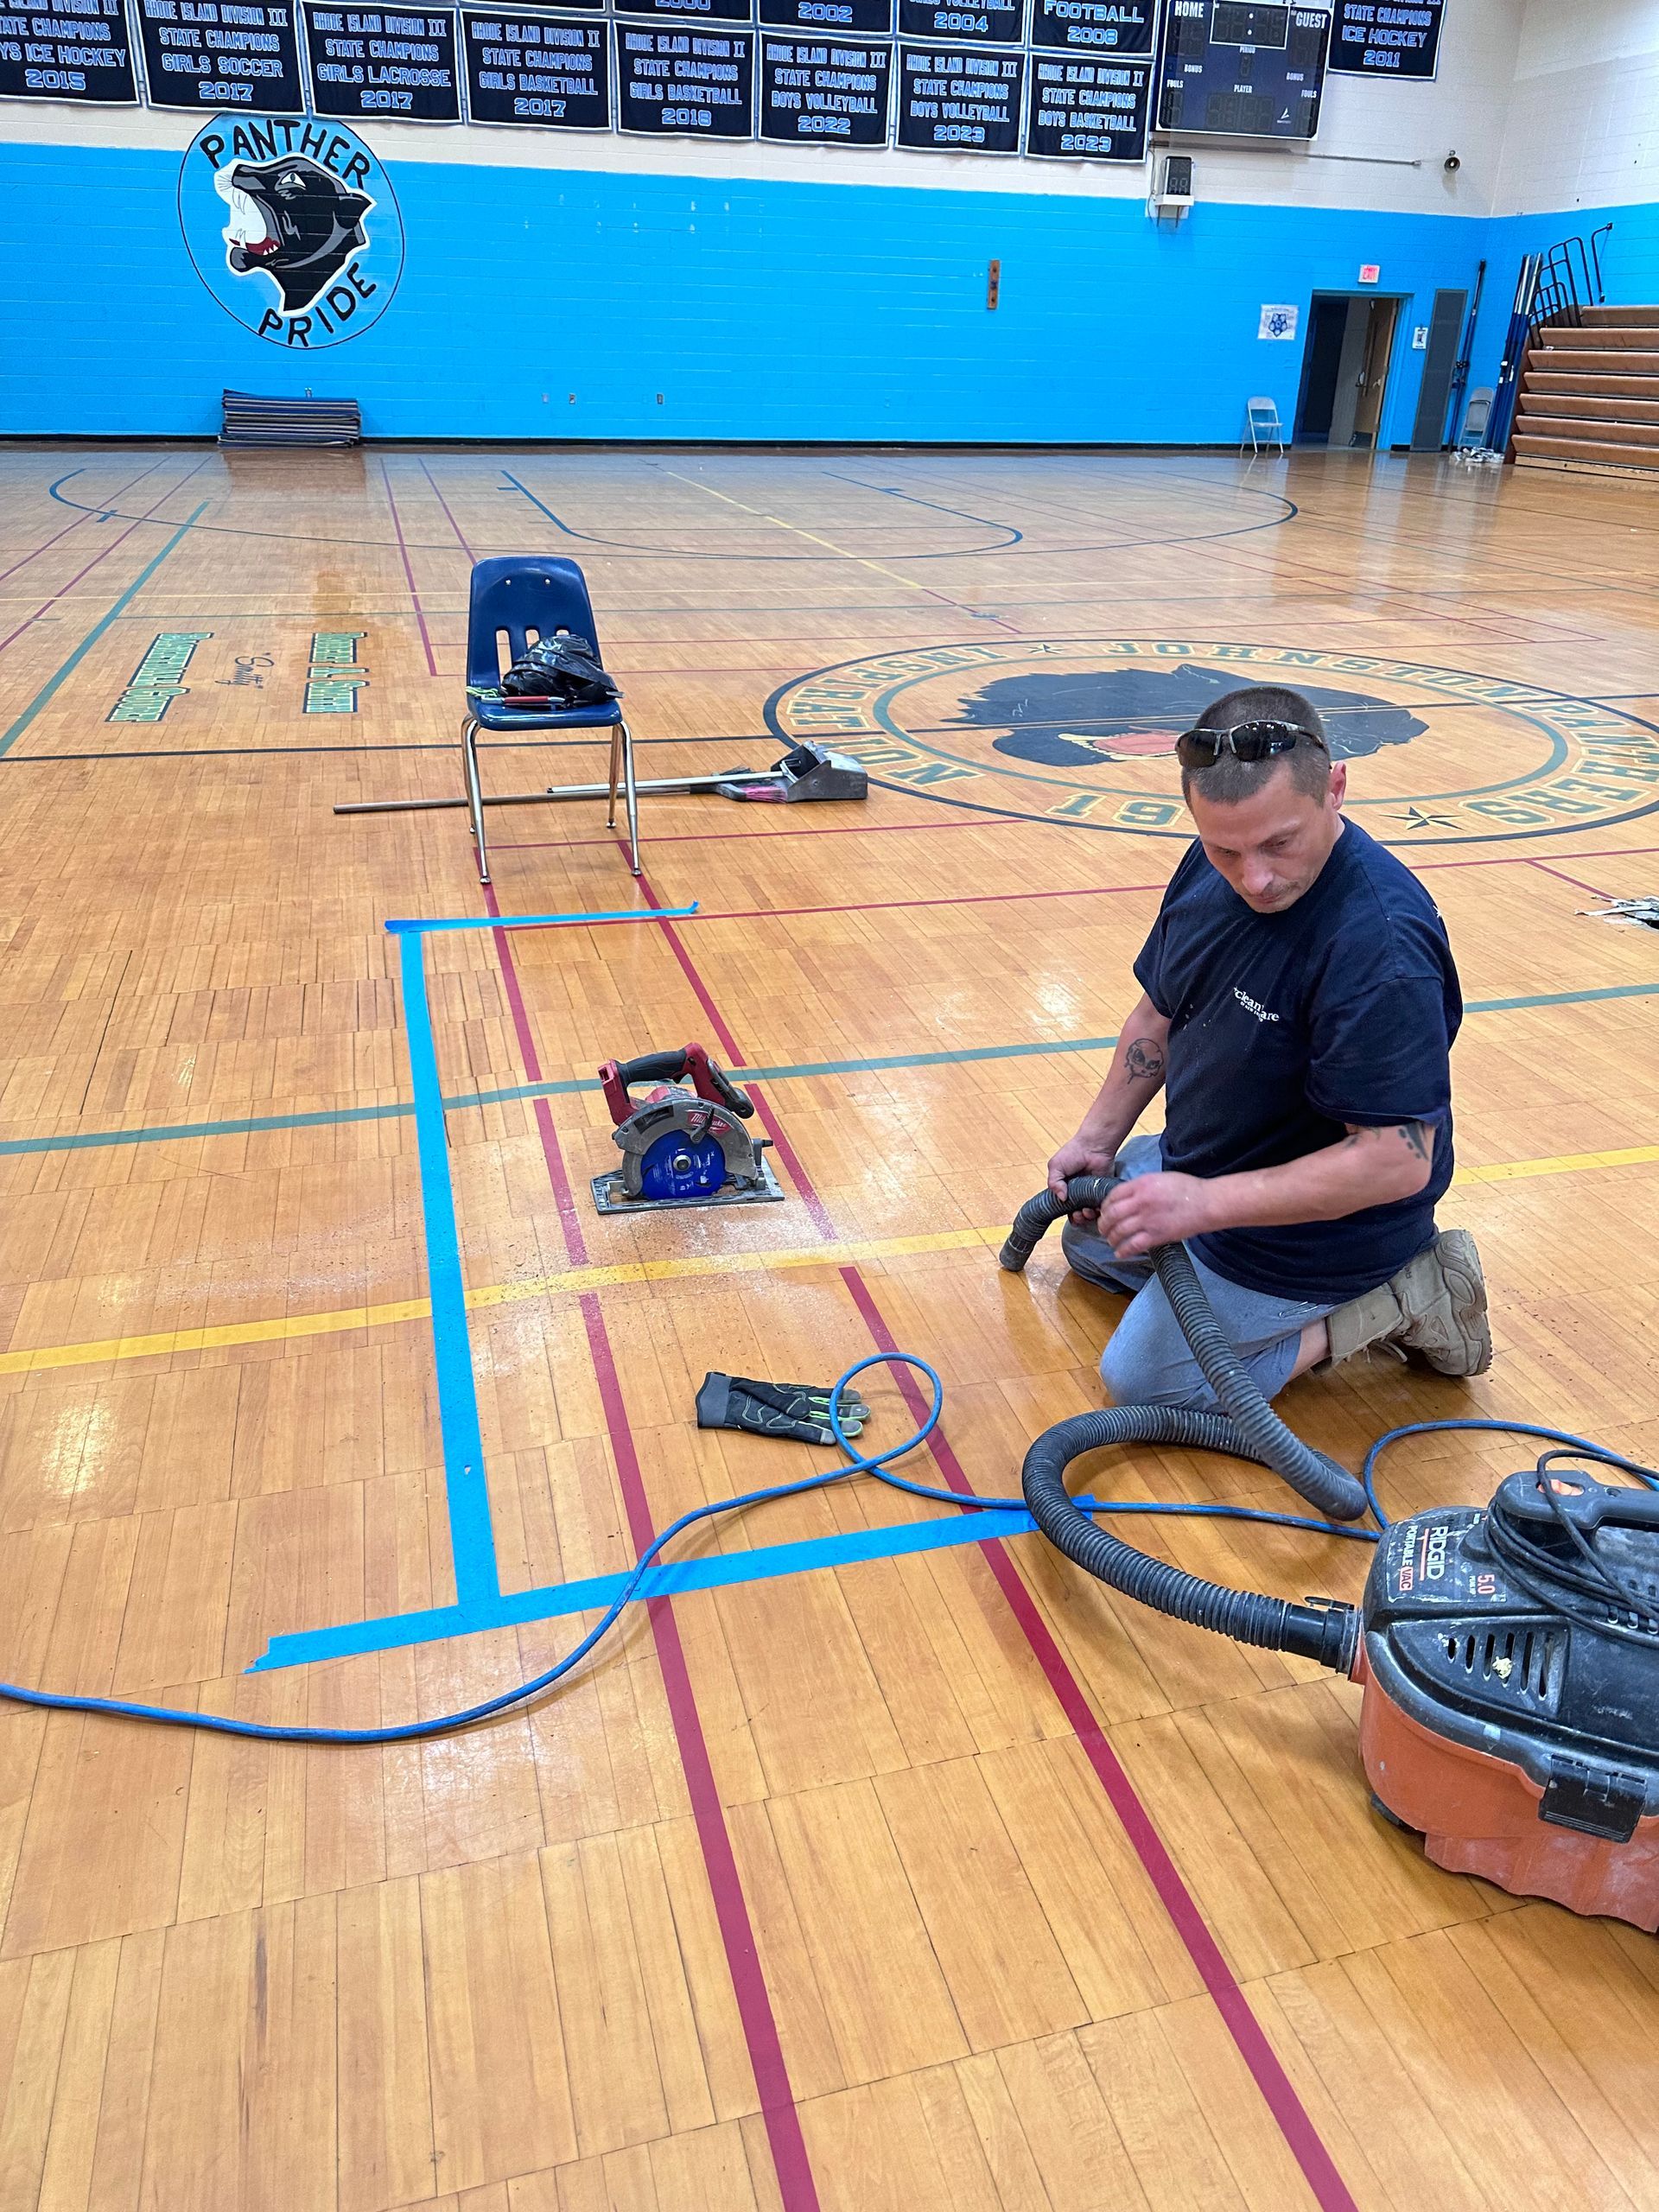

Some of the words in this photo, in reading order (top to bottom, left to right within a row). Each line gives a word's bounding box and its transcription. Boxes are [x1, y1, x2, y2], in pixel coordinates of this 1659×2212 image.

[104, 0, 119, 16] III
[144, 0, 177, 20] RHODE
[181, 3, 218, 22] ISLAND
[220, 4, 264, 25] DIVISION
[268, 8, 288, 27] III
[798, 2, 853, 22] 2002
[1044, 0, 1145, 23] FOOTBALL
[1174, 1, 1204, 18] HOME
[1344, 3, 1375, 22] STATE
[1377, 7, 1432, 26] CHAMPIONS
[0, 16, 29, 35] ATE
[32, 17, 111, 41] CHAMPIONS
[313, 12, 344, 31] RHODE
[347, 14, 381, 32] ISLAND
[385, 16, 424, 36] DIVISION
[428, 19, 447, 37] III
[934, 11, 988, 32] 2004
[1295, 12, 1327, 29] GUEST
[159, 27, 201, 48] STATE
[206, 29, 280, 52] CHAMPIONS
[471, 22, 502, 41] RHODE
[505, 24, 540, 43] ISLAND
[544, 27, 584, 47] DIVISION
[588, 30, 600, 48] II
[625, 32, 653, 52] RHODE
[658, 35, 689, 54] ISLAND
[692, 37, 730, 57] DIVISION
[734, 41, 745, 58] II
[1067, 26, 1117, 45] 2008
[1342, 25, 1366, 42] ICE
[1368, 29, 1427, 48] HOCKEY
[0, 41, 22, 61] YS
[25, 43, 55, 63] ICE
[58, 45, 126, 67] HOCKEY
[325, 39, 365, 58] STATE
[369, 41, 439, 61] CHAMPIONS
[482, 48, 521, 67] STATE
[525, 50, 593, 72] CHAMPIONS
[766, 43, 793, 63] RHODE
[797, 47, 828, 64] ISLAND
[830, 48, 867, 68] DIVISION
[869, 51, 887, 68] III
[1363, 50, 1400, 67] 2011
[162, 54, 211, 73] GIRLS
[218, 56, 283, 78] SOCCER
[316, 63, 364, 83] GIRLS
[368, 66, 451, 86] LACROSSE
[634, 58, 670, 77] STATE
[675, 60, 739, 81] CHAMPIONS
[906, 54, 931, 73] RHODE
[934, 56, 963, 73] ISLAND
[965, 58, 999, 77] DIVISION
[1001, 61, 1018, 78] III
[1038, 63, 1064, 82] RHODE
[1066, 66, 1095, 83] ISLAND
[1097, 67, 1130, 86] DIVISION
[1133, 71, 1144, 86] II
[1184, 64, 1202, 73] BONUS
[1286, 73, 1304, 81] BONUS
[25, 69, 86, 91] 2015
[199, 81, 253, 101] 2017
[479, 71, 515, 90] GIRLS
[518, 73, 598, 95] BASKETBALL
[774, 68, 810, 86] STATE
[815, 70, 876, 92] CHAMPIONS
[913, 78, 947, 96] STATE
[950, 80, 1008, 100] CHAMPIONS
[1166, 79, 1184, 88] FOULS
[1234, 85, 1252, 93] PLAYER
[360, 90, 413, 109] 2017
[630, 82, 664, 100] GIRLS
[668, 84, 742, 105] BASKETBALL
[772, 91, 801, 109] BOYS
[805, 92, 878, 114] VOLLEYBALL
[1042, 87, 1076, 105] STATE
[1079, 90, 1136, 109] CHAMPIONS
[1301, 90, 1317, 99] FOULS
[514, 98, 566, 118] 2017
[662, 108, 712, 127] 2018
[910, 100, 938, 118] BOYS
[942, 102, 1010, 123] VOLLEYBALL
[798, 115, 850, 135] 2022
[1039, 110, 1066, 127] BOYS
[1070, 111, 1137, 131] BASKETBALL
[933, 124, 985, 143] 2023
[1060, 134, 1112, 152] 2023
[200, 119, 370, 190] PANTHER
[258, 262, 377, 347] PRIDE
[1103, 640, 1571, 702] JOHNSTON
[1459, 703, 1659, 826] PANTHERS
[1045, 792, 1187, 828] 19
[1402, 1525, 1419, 1567] PORTABLE
[1427, 1526, 1448, 1580] RIDGID
[1400, 1567, 1412, 1591] VAC
[1478, 1574, 1495, 1594] 5.0
